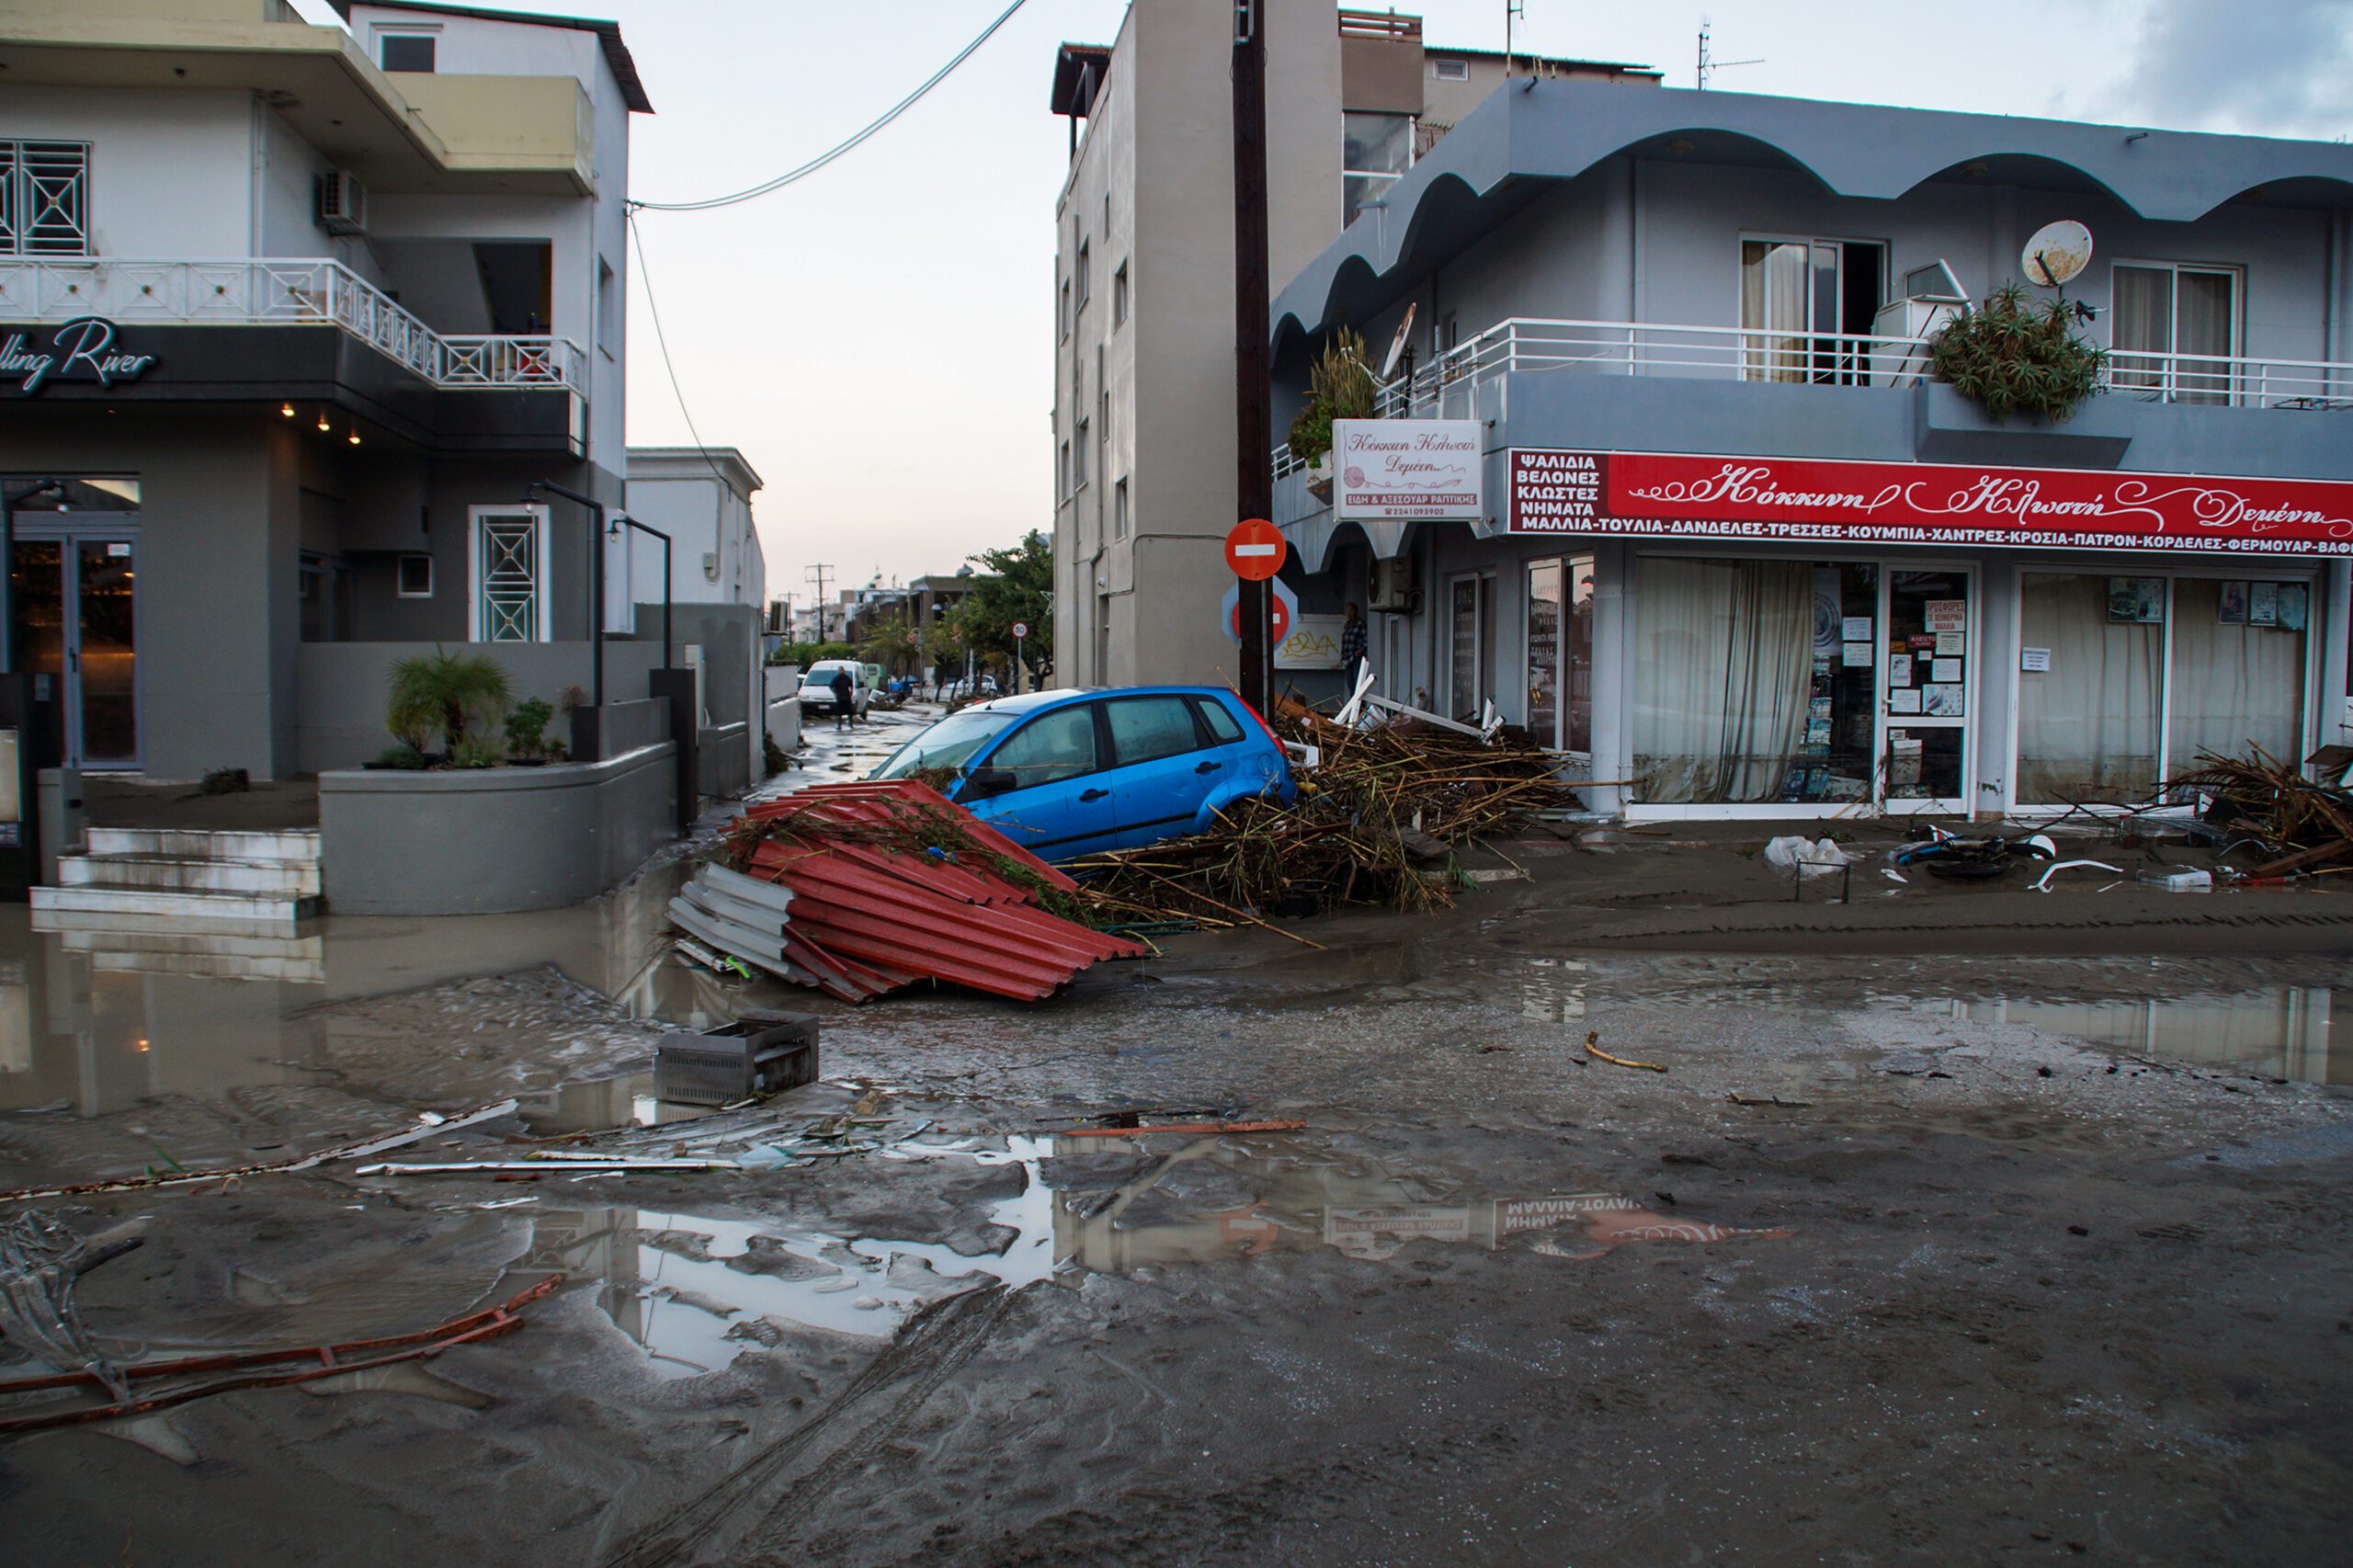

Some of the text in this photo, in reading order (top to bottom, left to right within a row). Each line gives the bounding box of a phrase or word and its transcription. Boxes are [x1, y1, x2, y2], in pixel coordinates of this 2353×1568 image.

[53, 321, 152, 382] River
[1520, 454, 1596, 470] ΨΑΛΙΔΙΑ
[1517, 471, 1599, 485] ΒΕΛΟΝΕΣ
[1347, 494, 1475, 505] ΕΙΔΗ & ΑΞΕΣΟΥΑΡ ΡΑΠΤΙΚΗΣ
[1518, 486, 1598, 501] ΚΛΩΣΤΕΣ
[1520, 502, 1595, 516] ΝΗΜΑΤΑ
